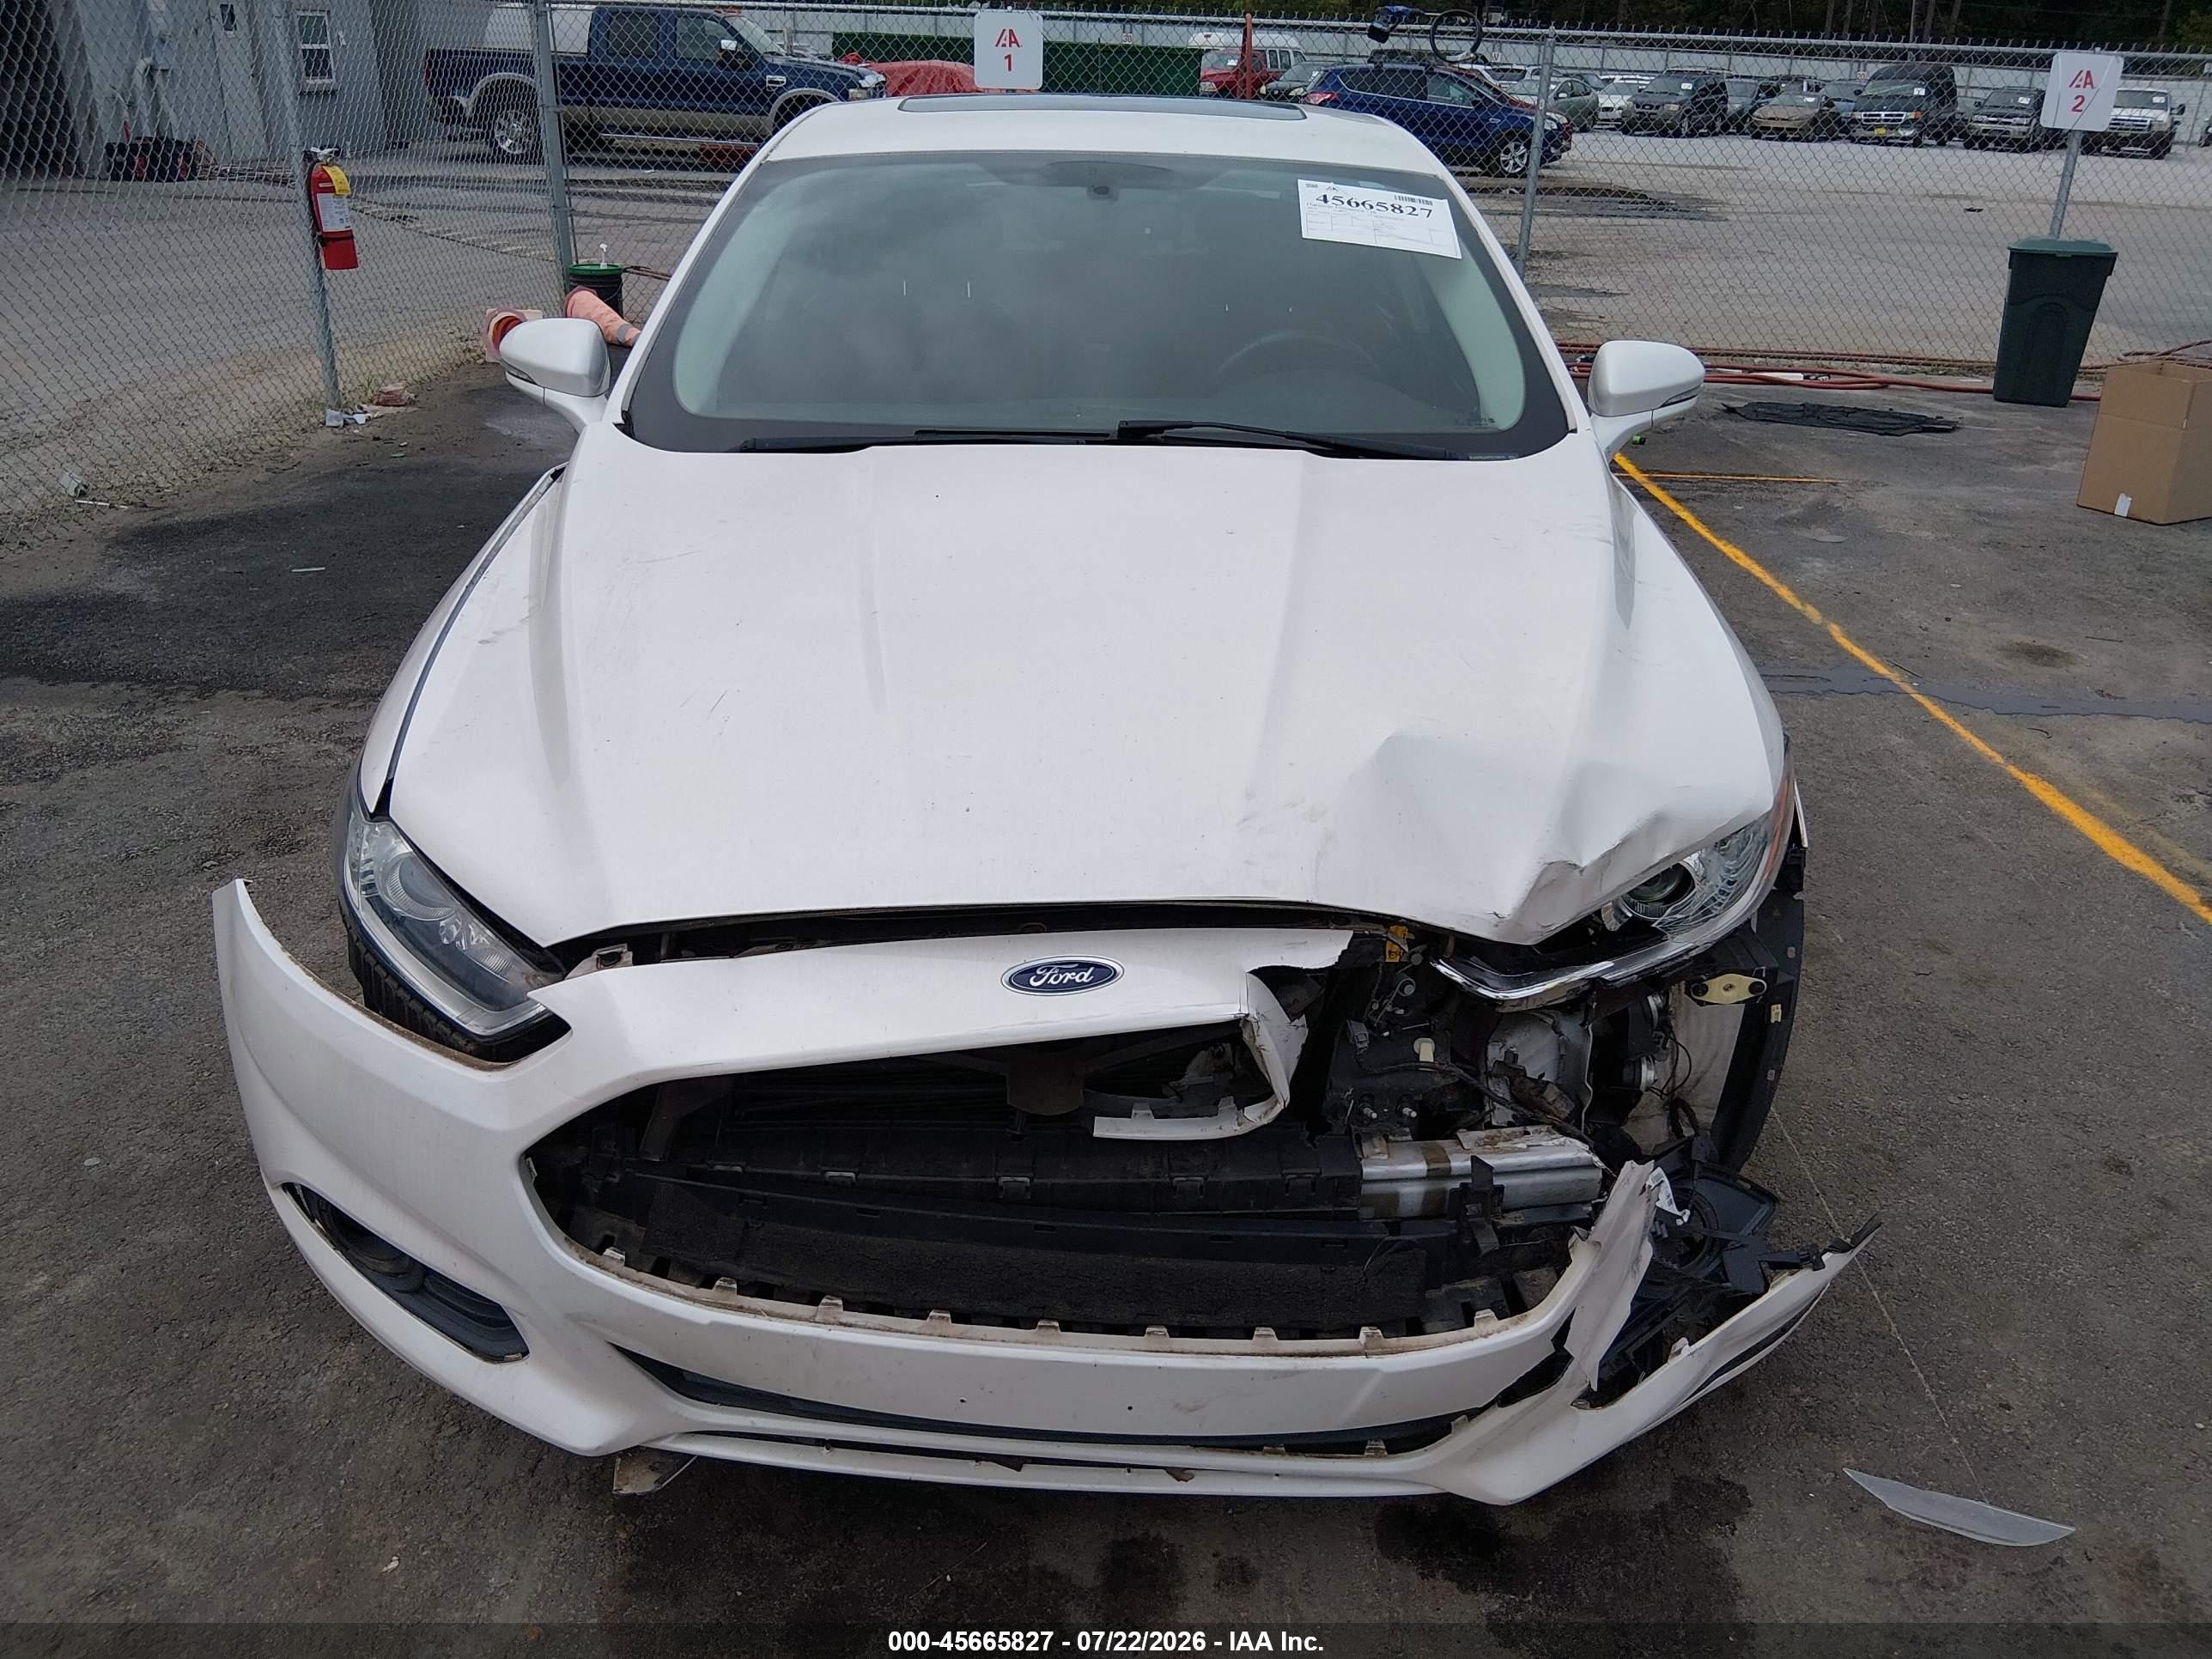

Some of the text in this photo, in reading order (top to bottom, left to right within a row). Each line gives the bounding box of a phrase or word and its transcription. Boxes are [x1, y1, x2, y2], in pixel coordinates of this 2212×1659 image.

[1004, 54, 1012, 71] 1
[2071, 94, 2085, 112] 2
[1315, 193, 1433, 219] 45665827
[1030, 963, 1095, 987] Ford
